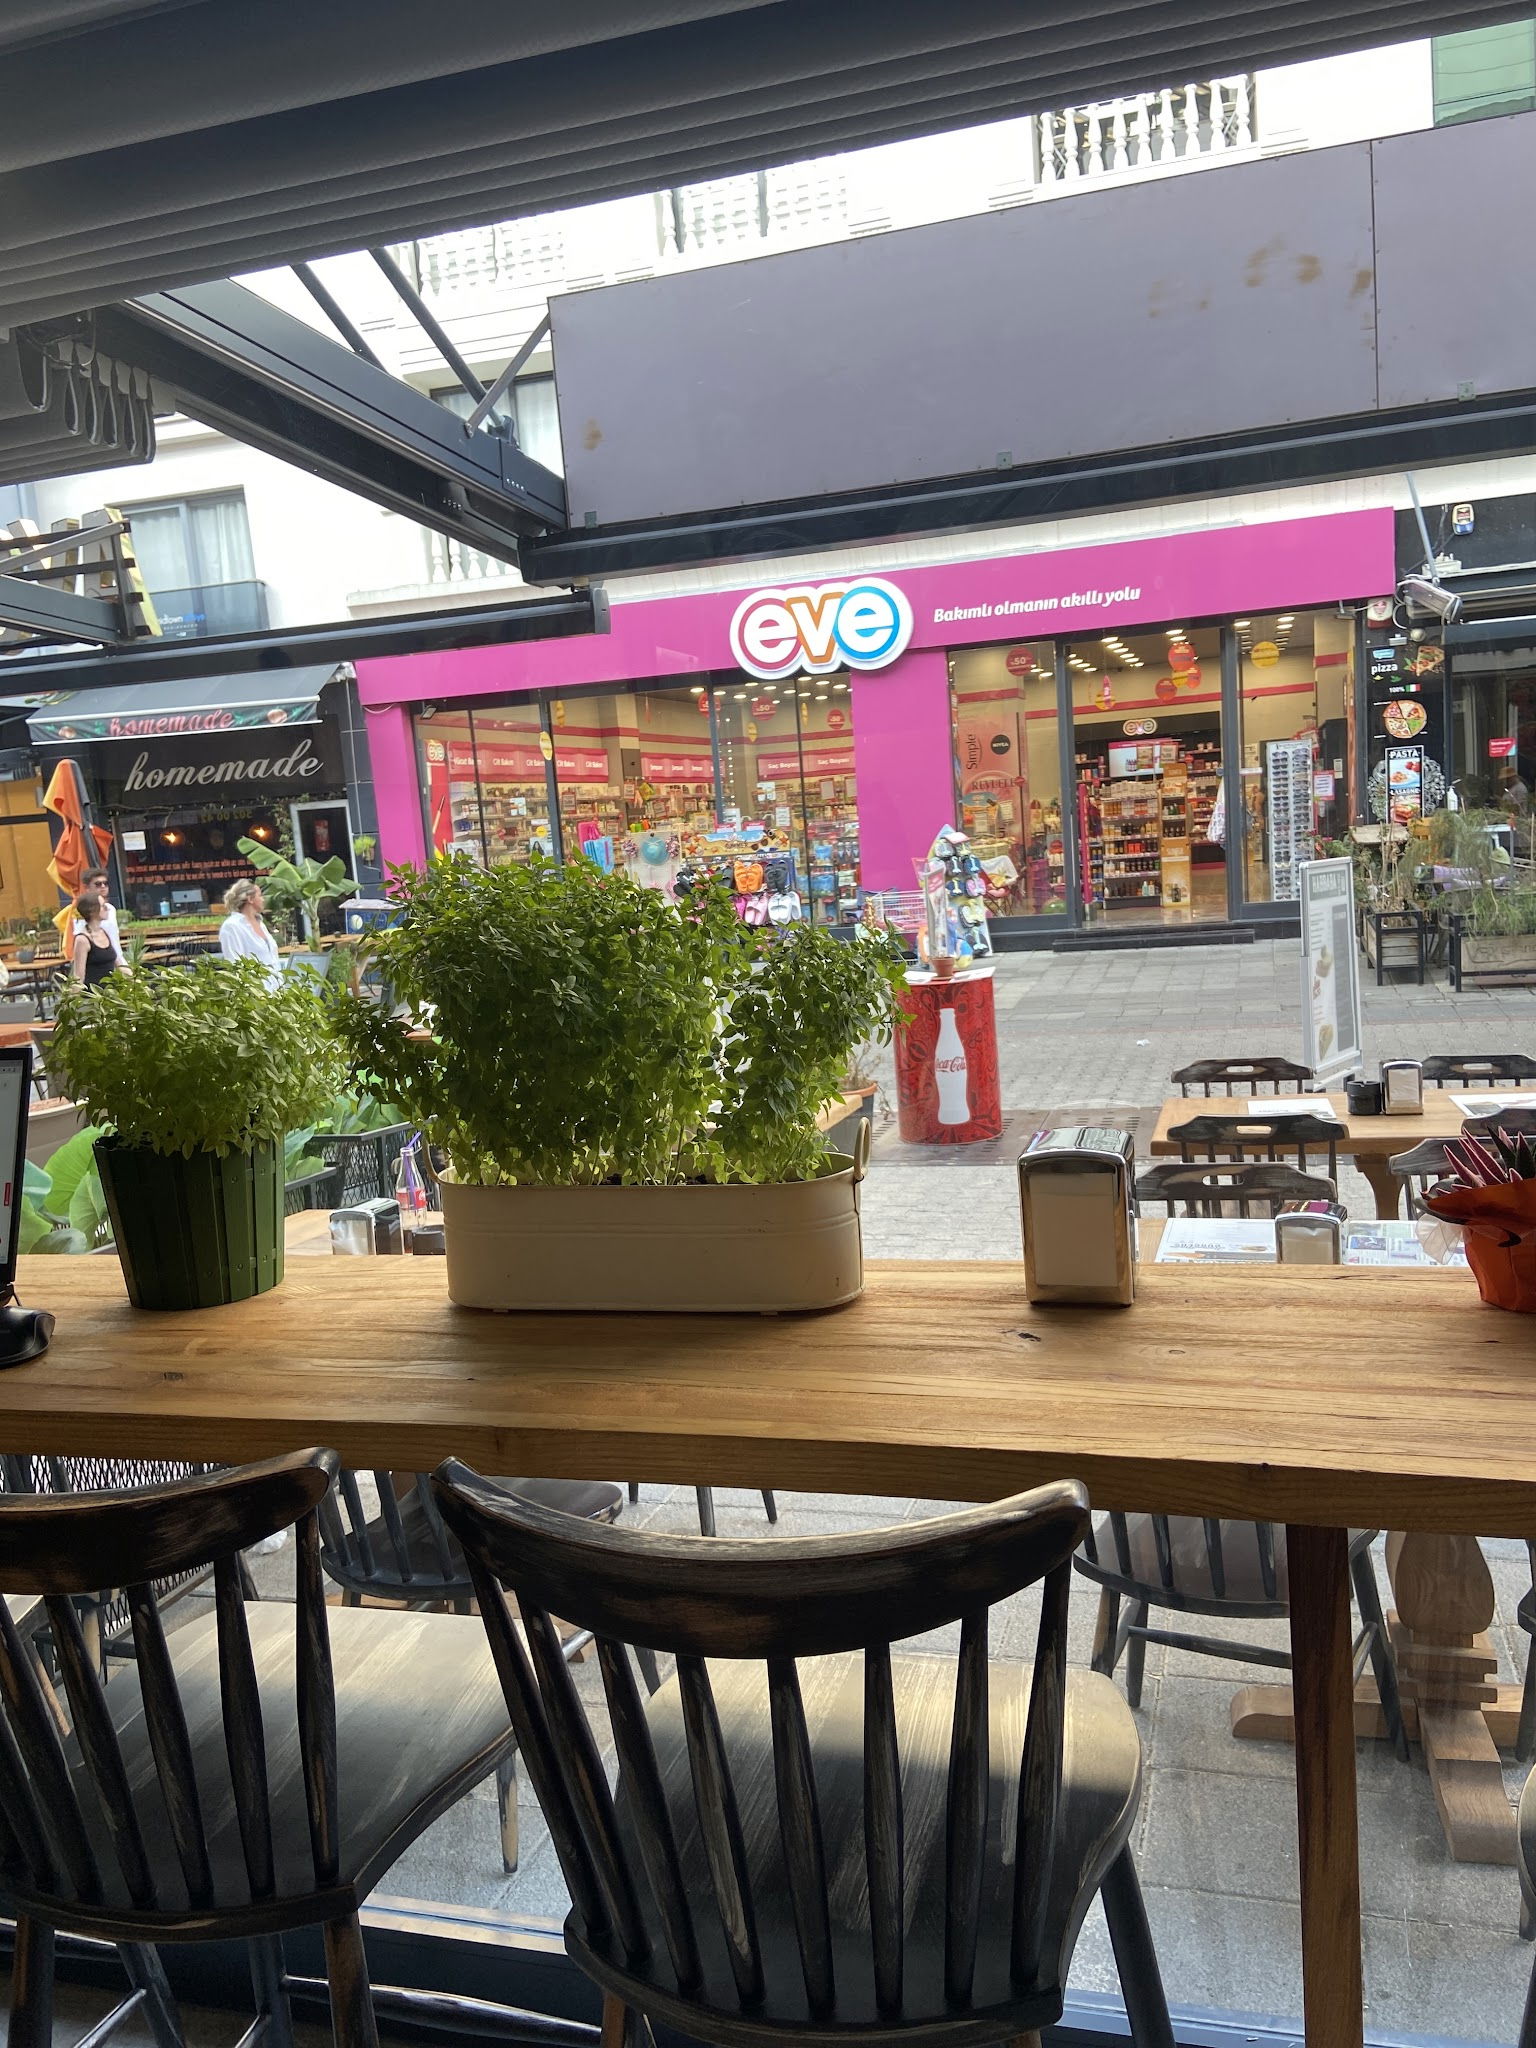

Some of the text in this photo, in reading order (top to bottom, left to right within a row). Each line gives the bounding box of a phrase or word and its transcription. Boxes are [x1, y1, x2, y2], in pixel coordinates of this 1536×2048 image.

[934, 586, 1141, 623] Bakımlı olmanın akıllı yolu
[738, 586, 900, 670] eve
[1371, 663, 1398, 675] pizza
[109, 709, 235, 737] homemade
[1123, 718, 1157, 736] eve
[124, 739, 323, 792] homemade
[966, 734, 980, 770] Simple
[1389, 749, 1419, 758] PASTA
